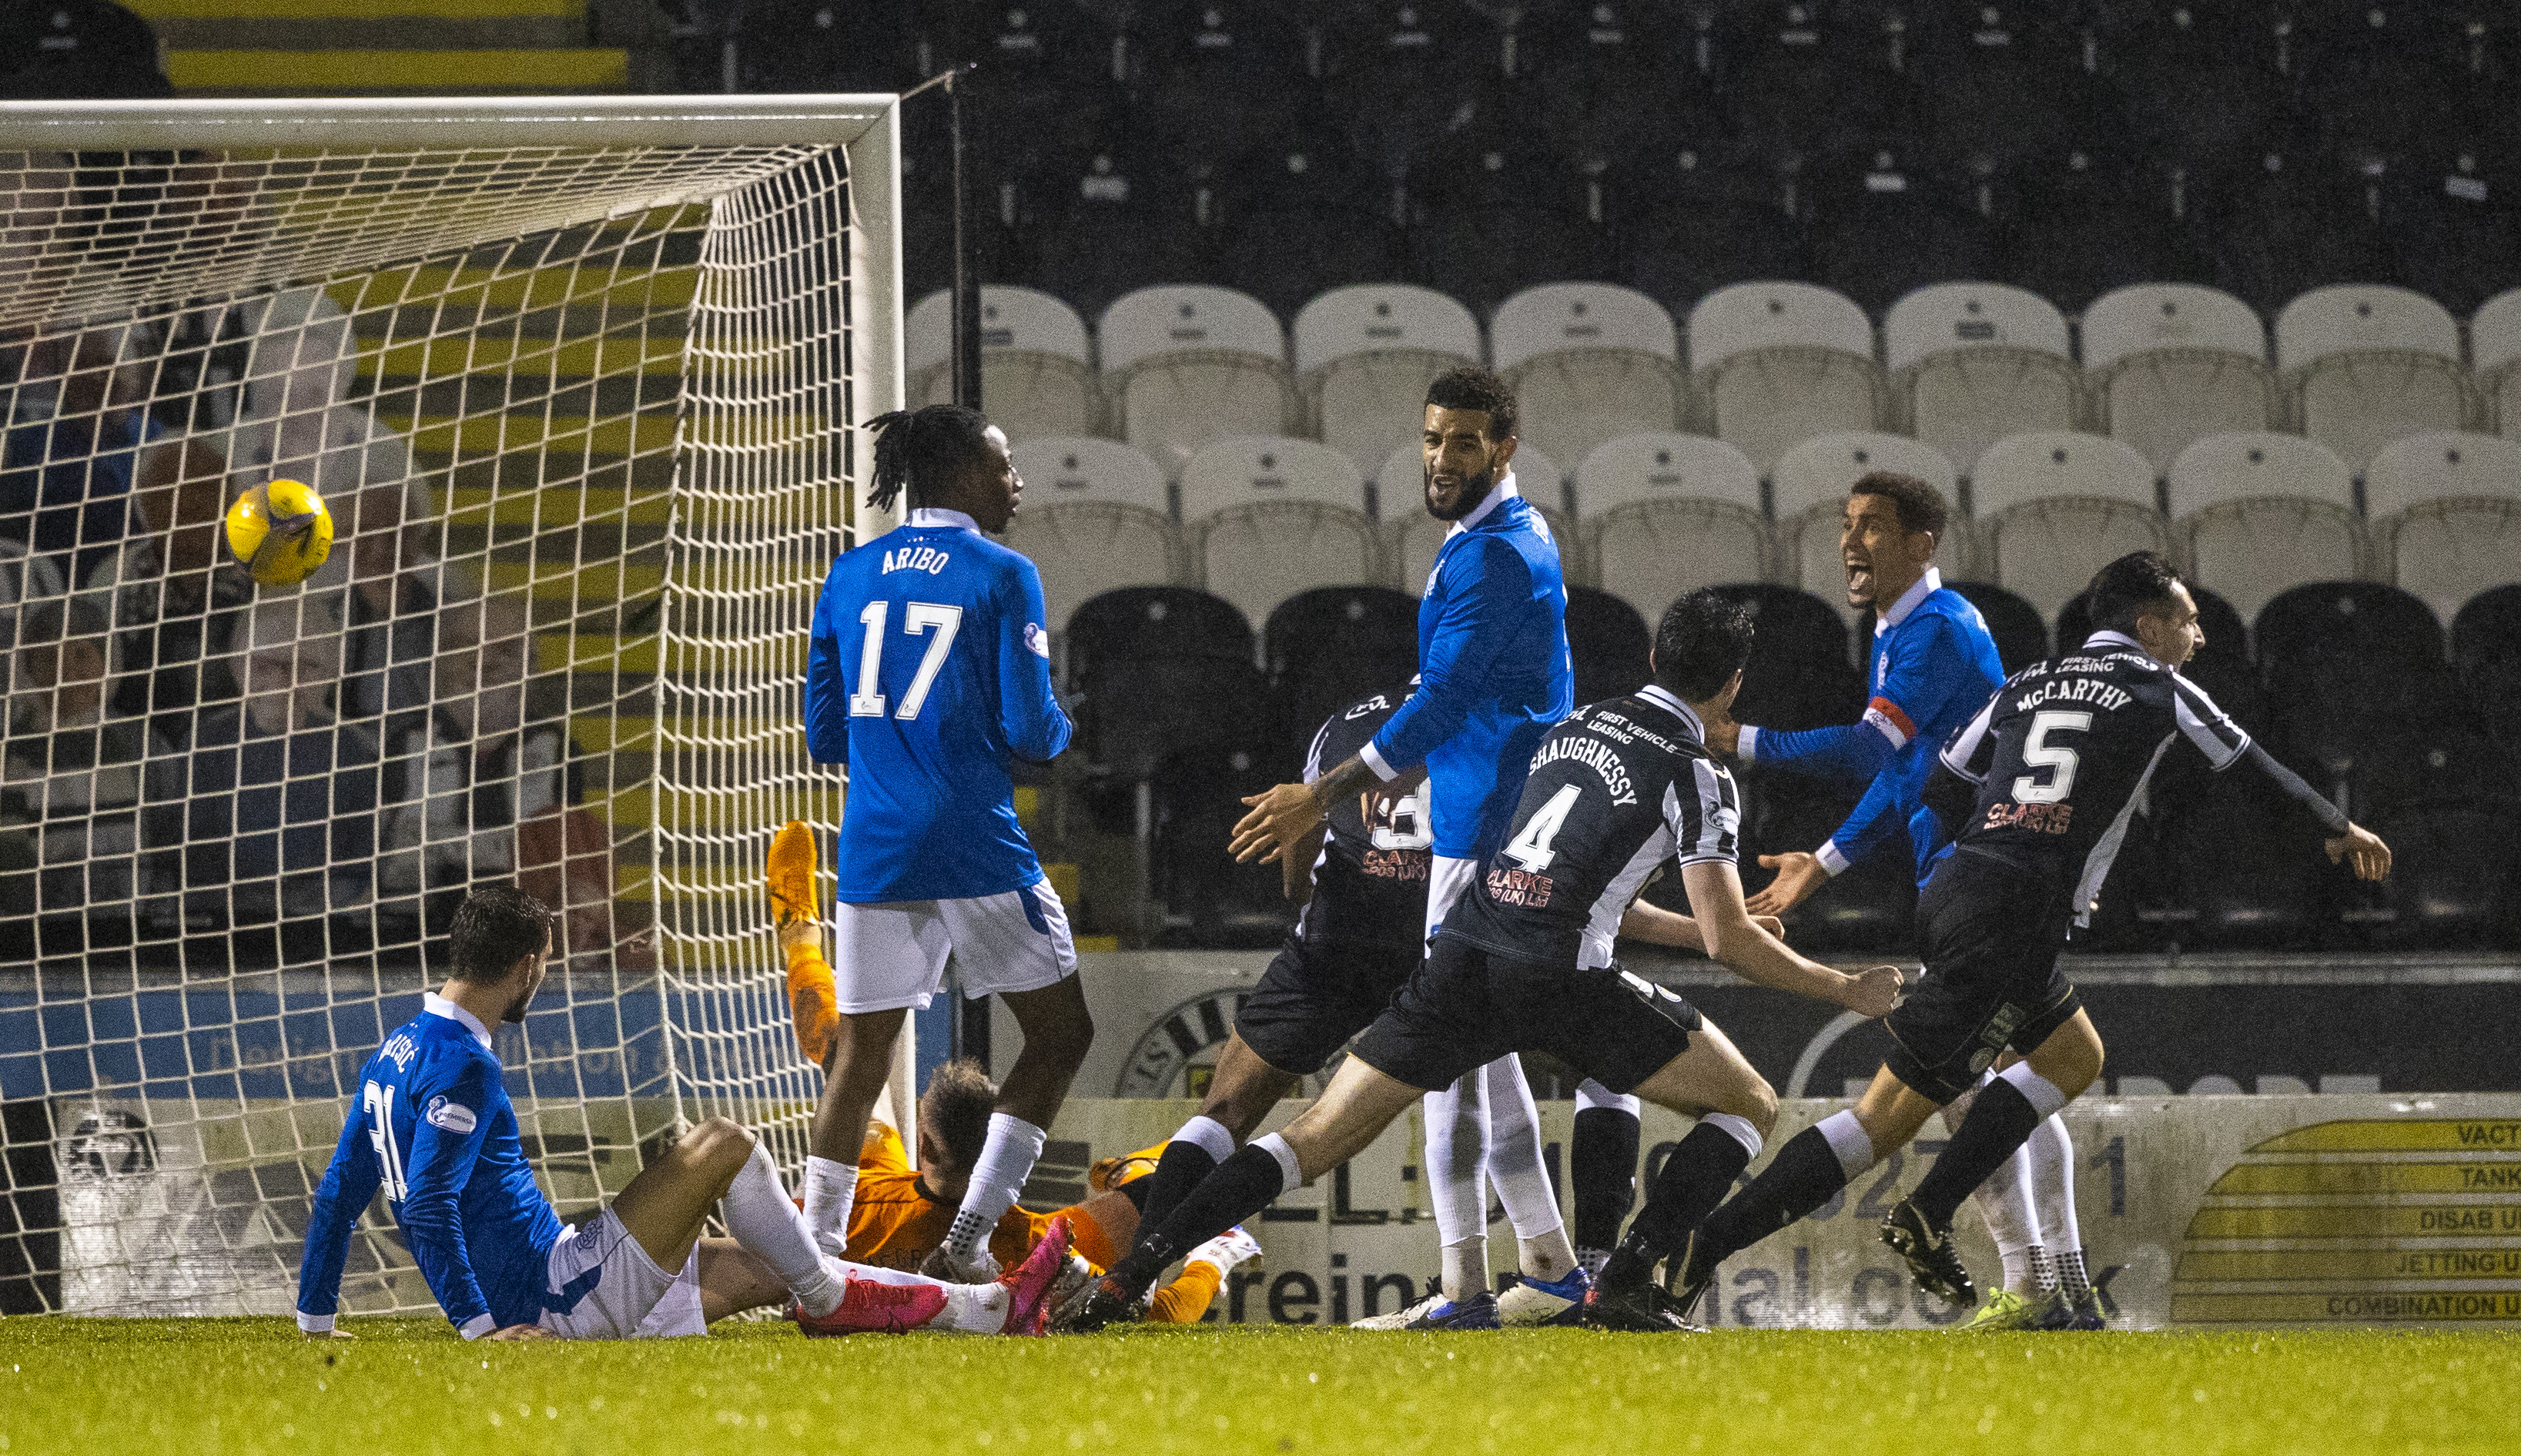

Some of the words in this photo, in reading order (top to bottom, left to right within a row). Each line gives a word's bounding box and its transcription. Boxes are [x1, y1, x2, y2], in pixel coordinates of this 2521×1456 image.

[882, 547, 949, 575] ARIBO
[849, 601, 963, 720] 17
[2055, 661, 2114, 674] LEASING
[1586, 719, 1635, 745] LEASING
[1595, 710, 1629, 726] FIRST
[1625, 725, 1679, 754] VEHICLE
[2011, 710, 2094, 804] 5
[1528, 736, 1638, 807] SHAUGHNESSY
[1502, 783, 1582, 874] 4
[1486, 869, 1554, 897] CLARKE
[363, 1079, 407, 1203] 31
[2420, 1209, 2494, 1230] DISAB
[2396, 1253, 2496, 1273] JETTING
[2328, 1295, 2497, 1317] COMBINATION
